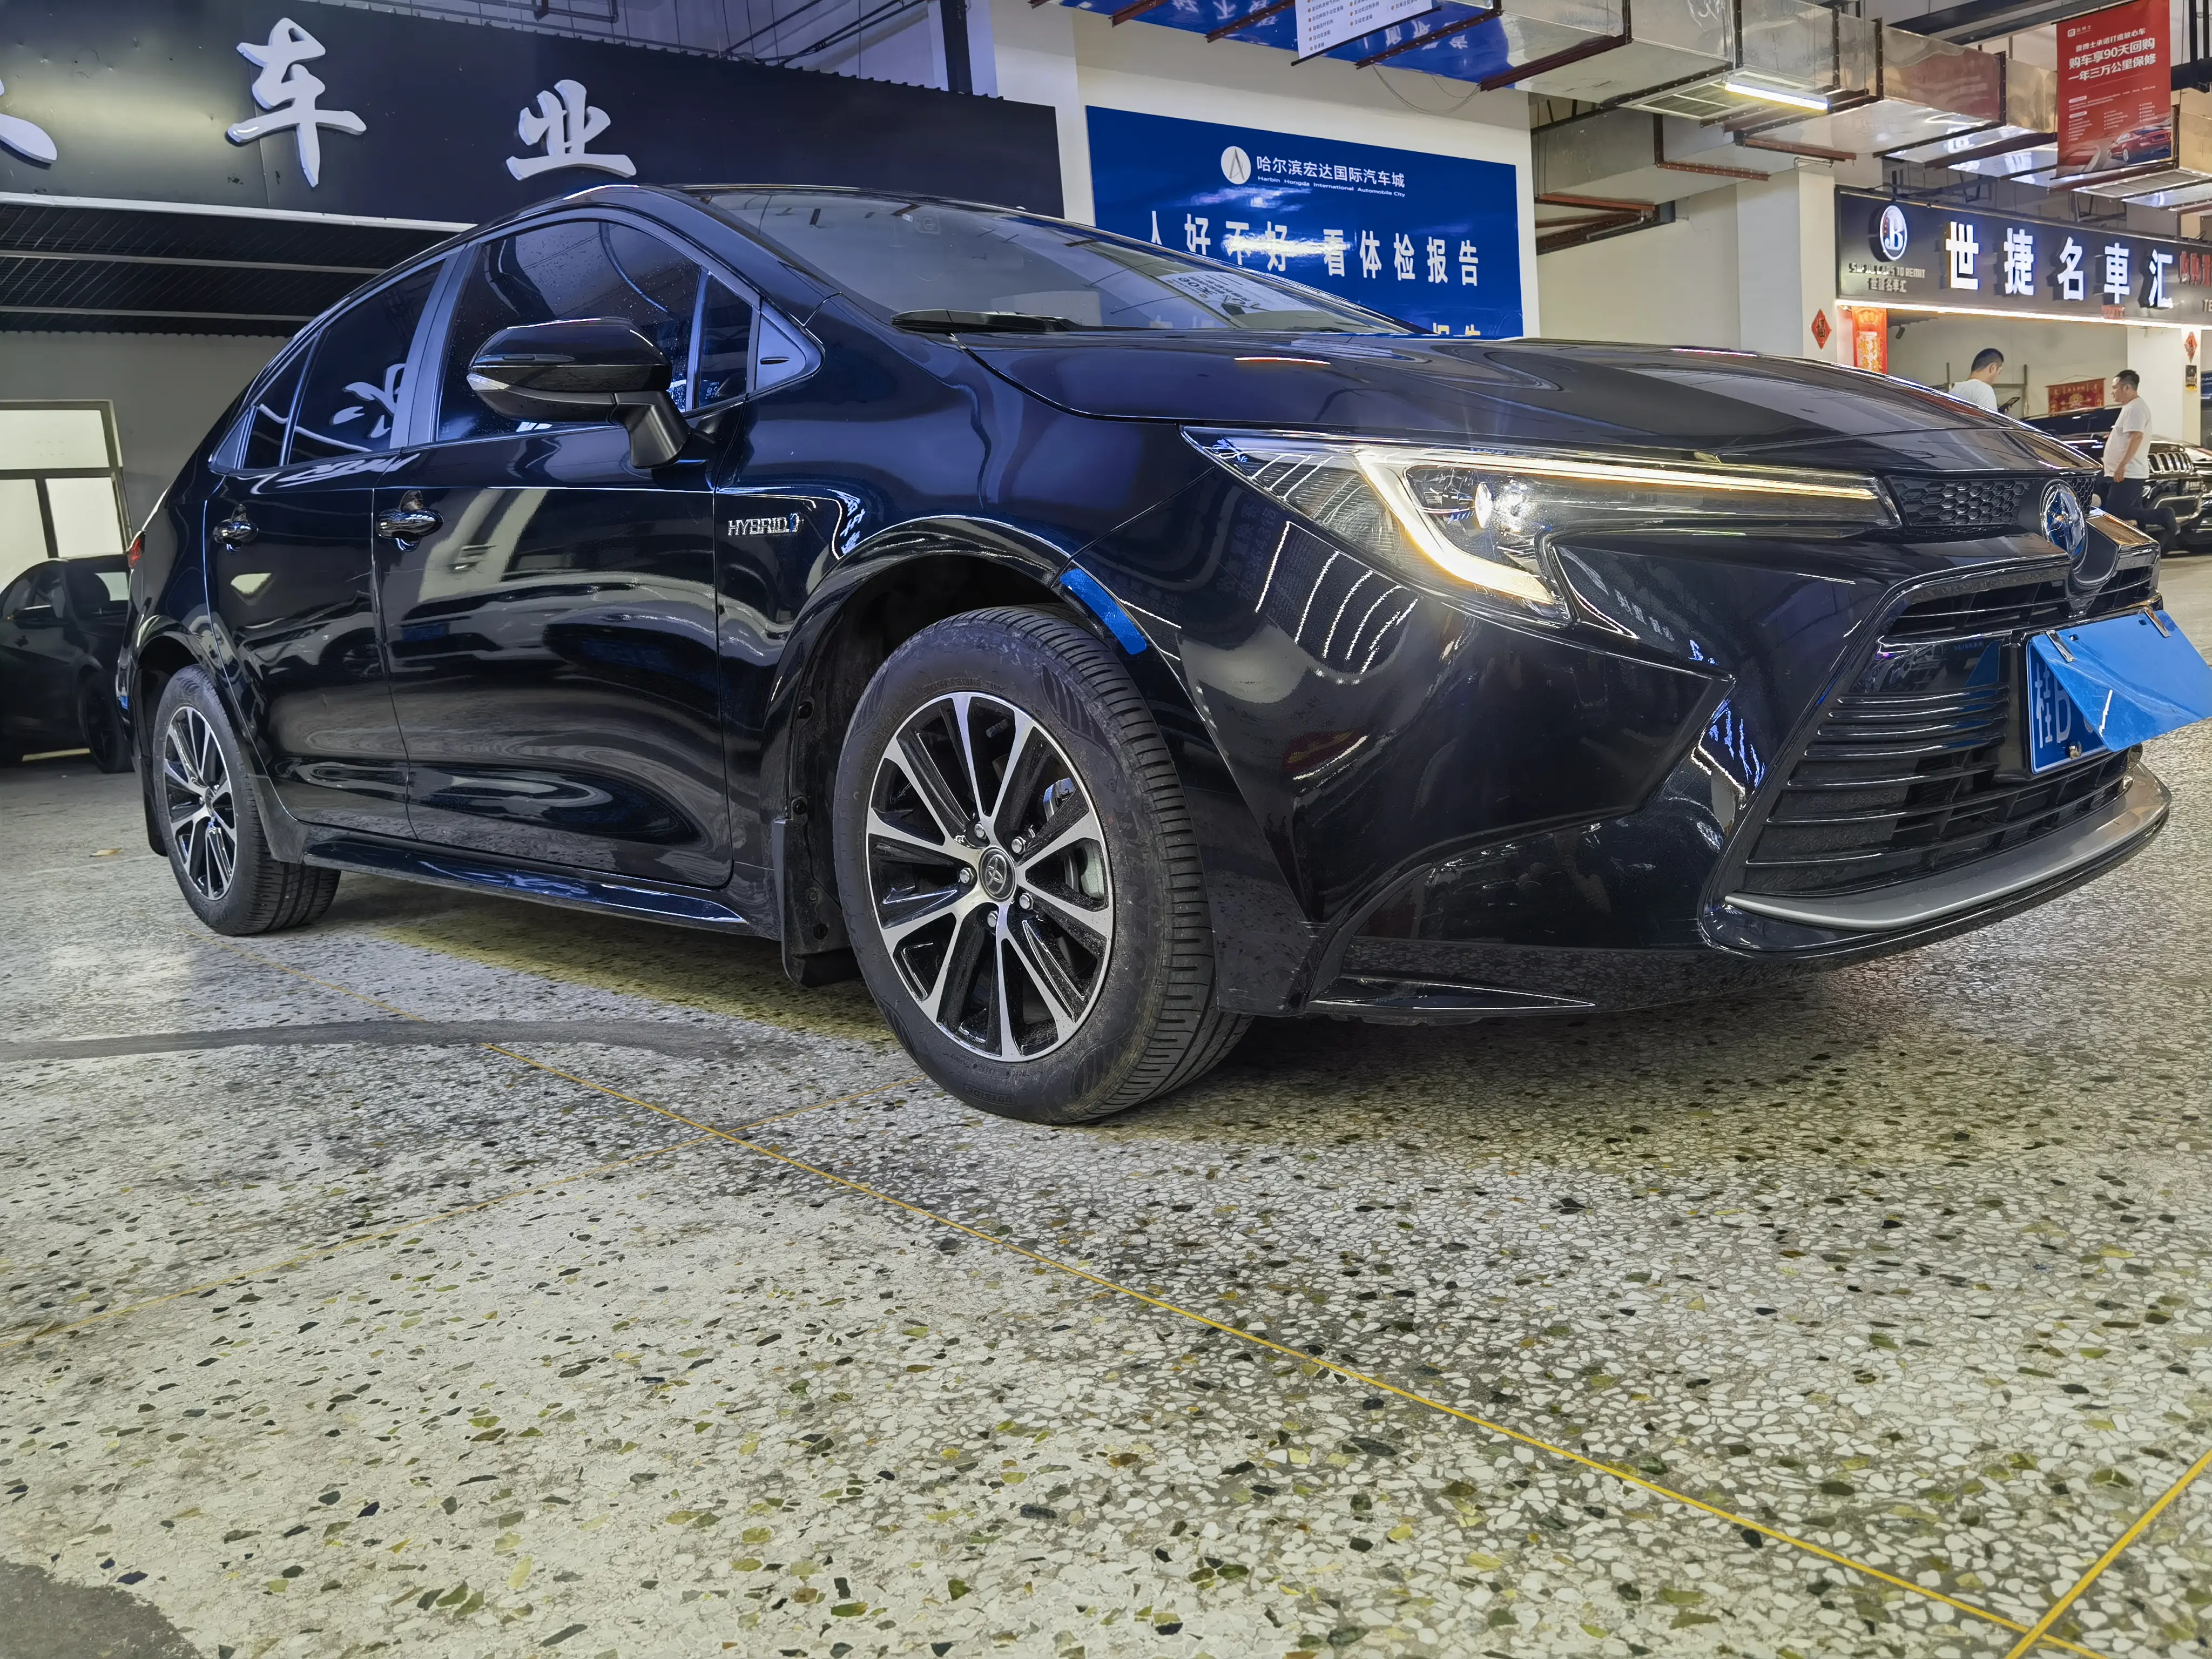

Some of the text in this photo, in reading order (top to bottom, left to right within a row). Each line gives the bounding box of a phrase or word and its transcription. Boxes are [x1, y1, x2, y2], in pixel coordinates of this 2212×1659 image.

[2068, 53, 2156, 81] 一年三万公里保修
[2069, 37, 2155, 70] 购车享90天回购
[1256, 156, 1405, 188] 哈尔滨宏达国际汽车城
[1284, 179, 1310, 187] Hongda
[1313, 182, 1354, 191] International
[1357, 187, 1392, 195] Automobile
[1897, 267, 1904, 276] TO
[1945, 221, 2173, 308] 世捷名車汇
[728, 516, 790, 536] HYBRID
